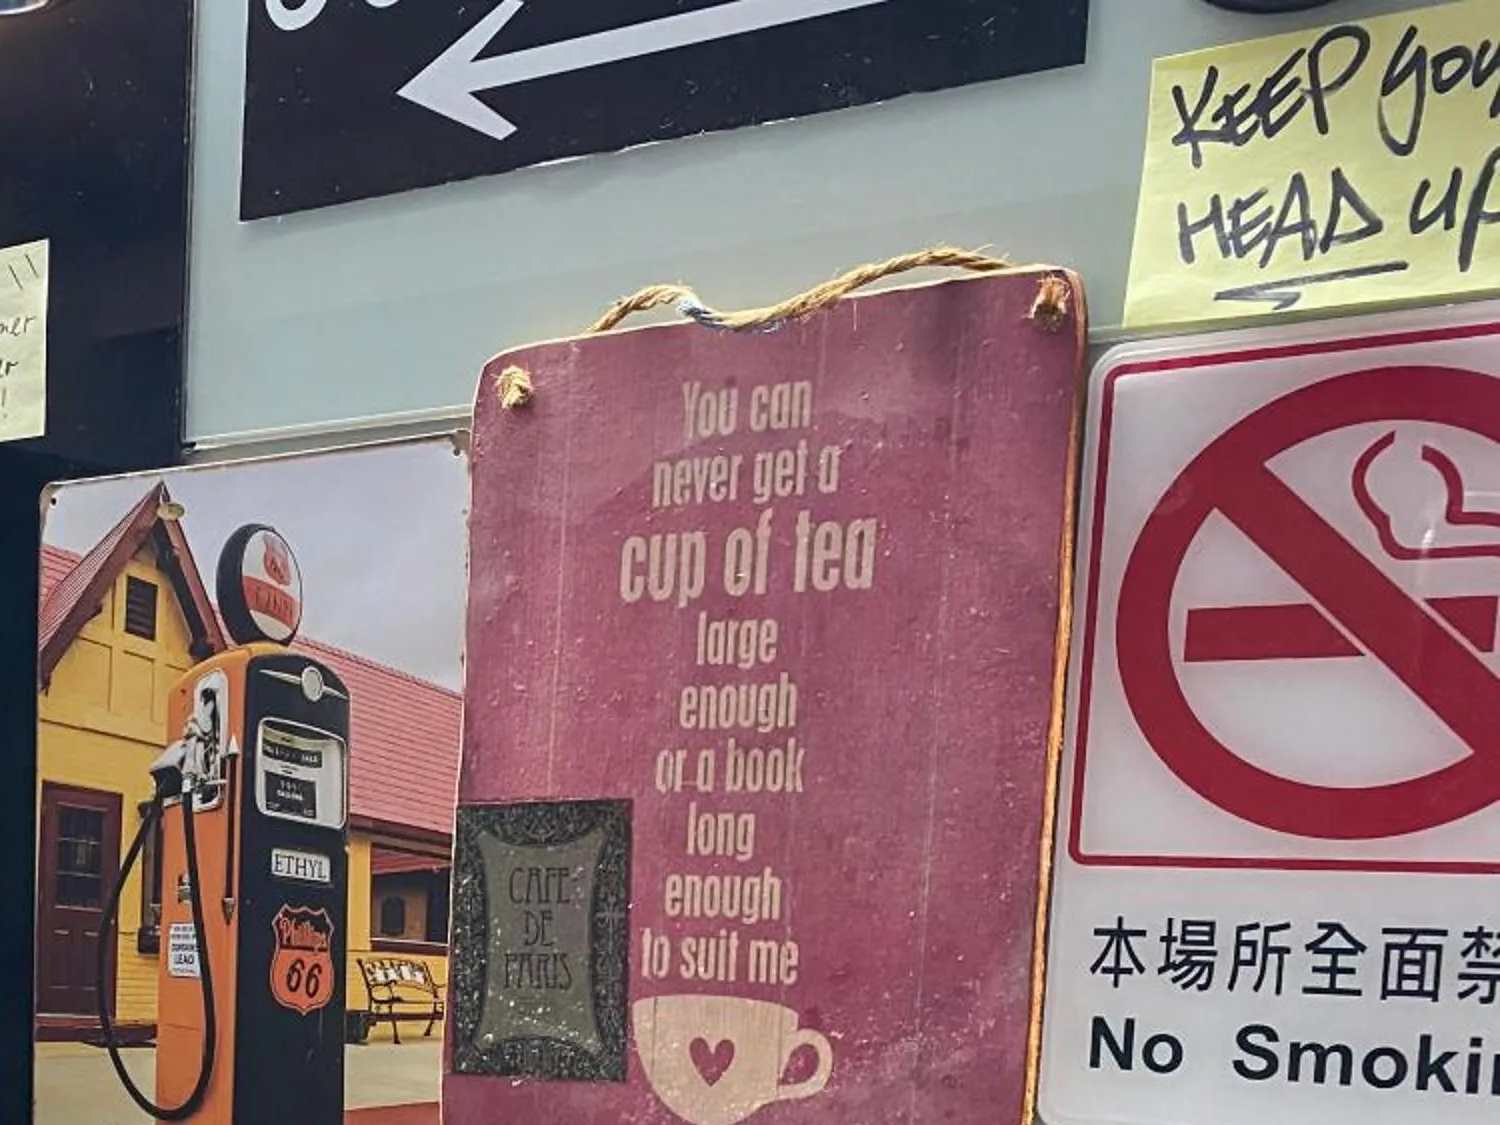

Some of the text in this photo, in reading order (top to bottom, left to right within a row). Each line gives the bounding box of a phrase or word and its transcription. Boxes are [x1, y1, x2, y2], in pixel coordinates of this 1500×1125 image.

[1172, 25, 1371, 168] KEEP
[1177, 167, 1383, 269] HEAD
[682, 380, 813, 439] You can
[653, 439, 843, 508] never get a
[619, 508, 877, 609] cup of tea
[696, 611, 778, 670] large
[679, 672, 798, 733] enough
[656, 737, 805, 794] or a book
[686, 801, 755, 861] long
[274, 853, 328, 880] ETHYL
[509, 867, 570, 904] CAFE
[664, 867, 782, 924] enough
[524, 910, 554, 947] DE
[640, 927, 799, 985] to suit me
[285, 958, 322, 998] 66
[503, 953, 573, 990] PARIS
[1089, 1015, 1500, 1096] No Smoki
